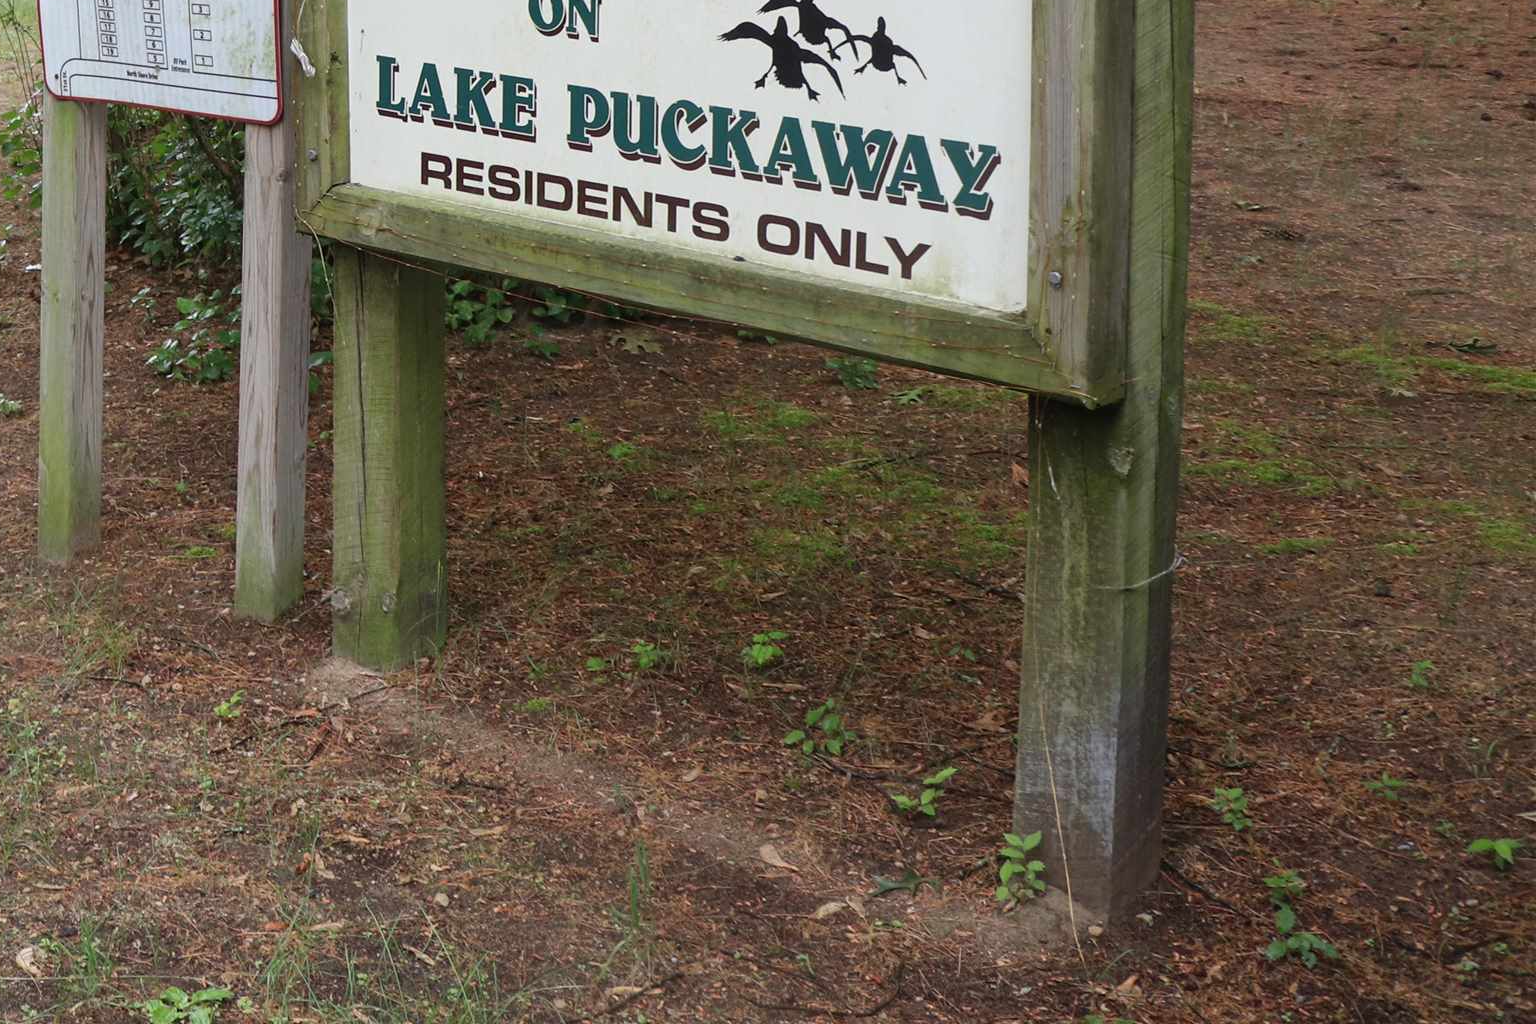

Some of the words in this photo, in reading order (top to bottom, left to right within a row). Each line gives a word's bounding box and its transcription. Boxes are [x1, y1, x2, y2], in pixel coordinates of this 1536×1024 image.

[375, 55, 537, 143] LAKE
[566, 84, 1001, 221] PUCKAWAY
[420, 152, 730, 243] RESIDENTS
[757, 213, 932, 280] ONLY
